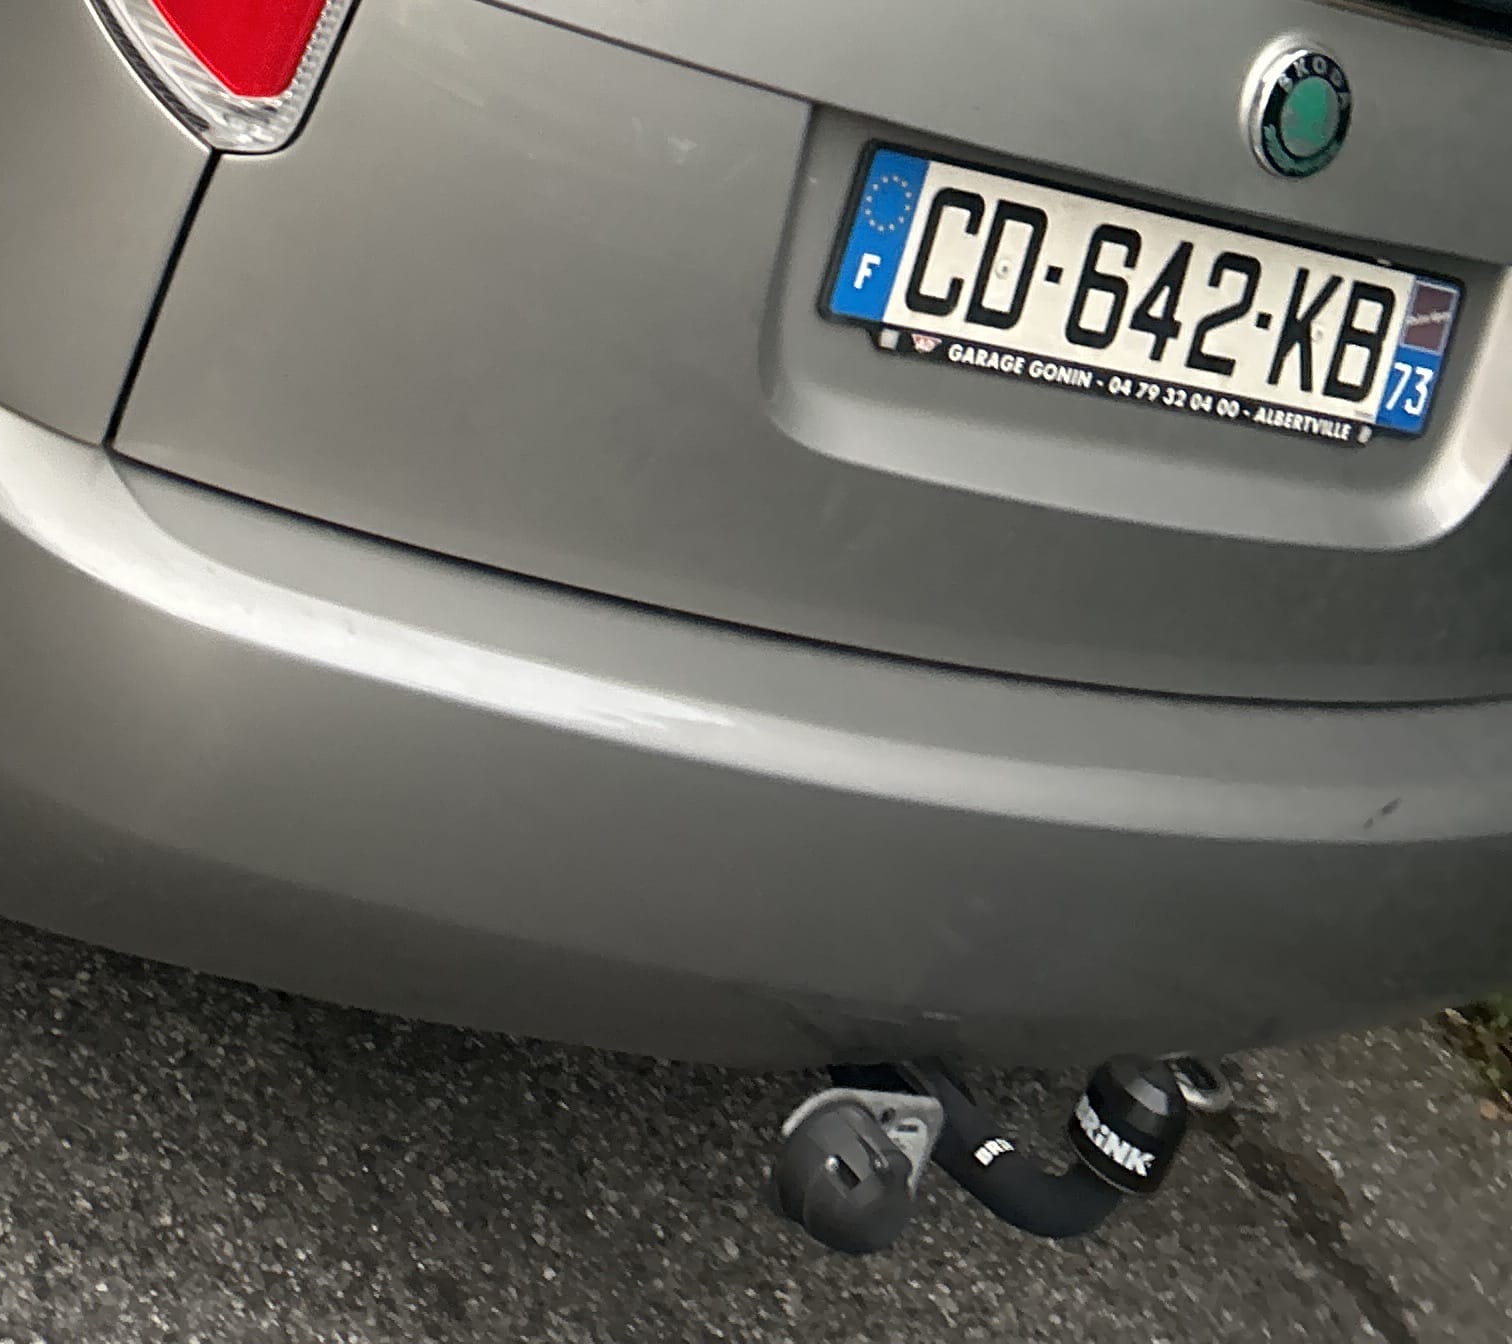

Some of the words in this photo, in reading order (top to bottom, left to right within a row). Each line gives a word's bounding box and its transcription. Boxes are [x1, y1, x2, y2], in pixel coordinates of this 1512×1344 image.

[853, 253, 881, 290] F
[905, 187, 1397, 403] CD-642-KB
[947, 343, 1026, 375] GARAGE
[1028, 360, 1093, 389] GONIN
[1107, 376, 1132, 398] 04
[1135, 382, 1162, 403] 79
[1162, 387, 1189, 409] 32
[1189, 392, 1214, 414] 04
[1216, 397, 1241, 420] 00
[1253, 406, 1352, 441] ALBERTVILLE
[1385, 362, 1434, 417] 73
